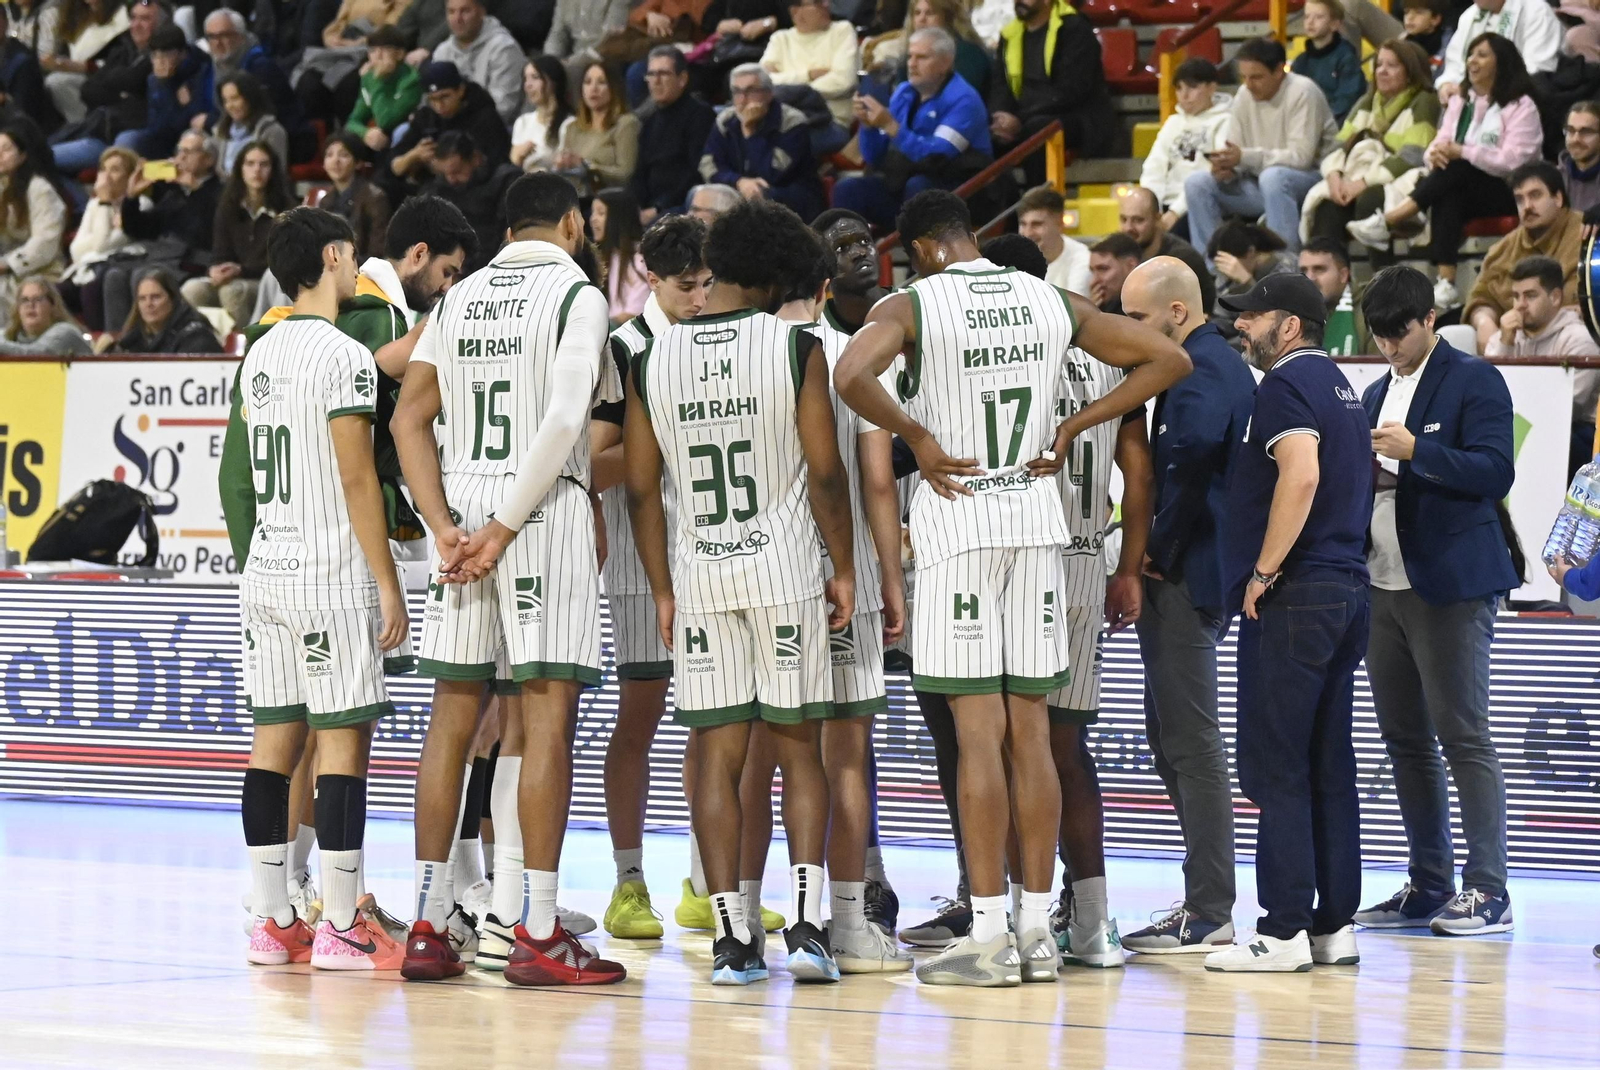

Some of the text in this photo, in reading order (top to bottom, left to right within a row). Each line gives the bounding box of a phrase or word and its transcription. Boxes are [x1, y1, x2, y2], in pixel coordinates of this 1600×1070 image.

[464, 299, 528, 321] SCHUTTE
[965, 306, 1033, 329] SAGNIA
[486, 336, 522, 357] RAHI
[994, 343, 1044, 366] RAHI
[699, 358, 732, 382] J-M
[964, 366, 1024, 376] SOLUCIONES INTEGRALES
[130, 378, 172, 406] San
[982, 392, 994, 402] CCB
[709, 397, 757, 419] RAHI
[471, 380, 511, 461] 15
[680, 422, 712, 430] SOLUCIONES
[981, 386, 1032, 469] 17
[253, 425, 291, 505] 90
[688, 439, 759, 527] 35
[696, 516, 709, 526] CCB
[953, 624, 983, 633] Hospital
[953, 632, 984, 641] Arruzafa
[306, 664, 332, 672] REALE
[687, 656, 714, 666] Hospital
[687, 665, 716, 674] Arruzafa
